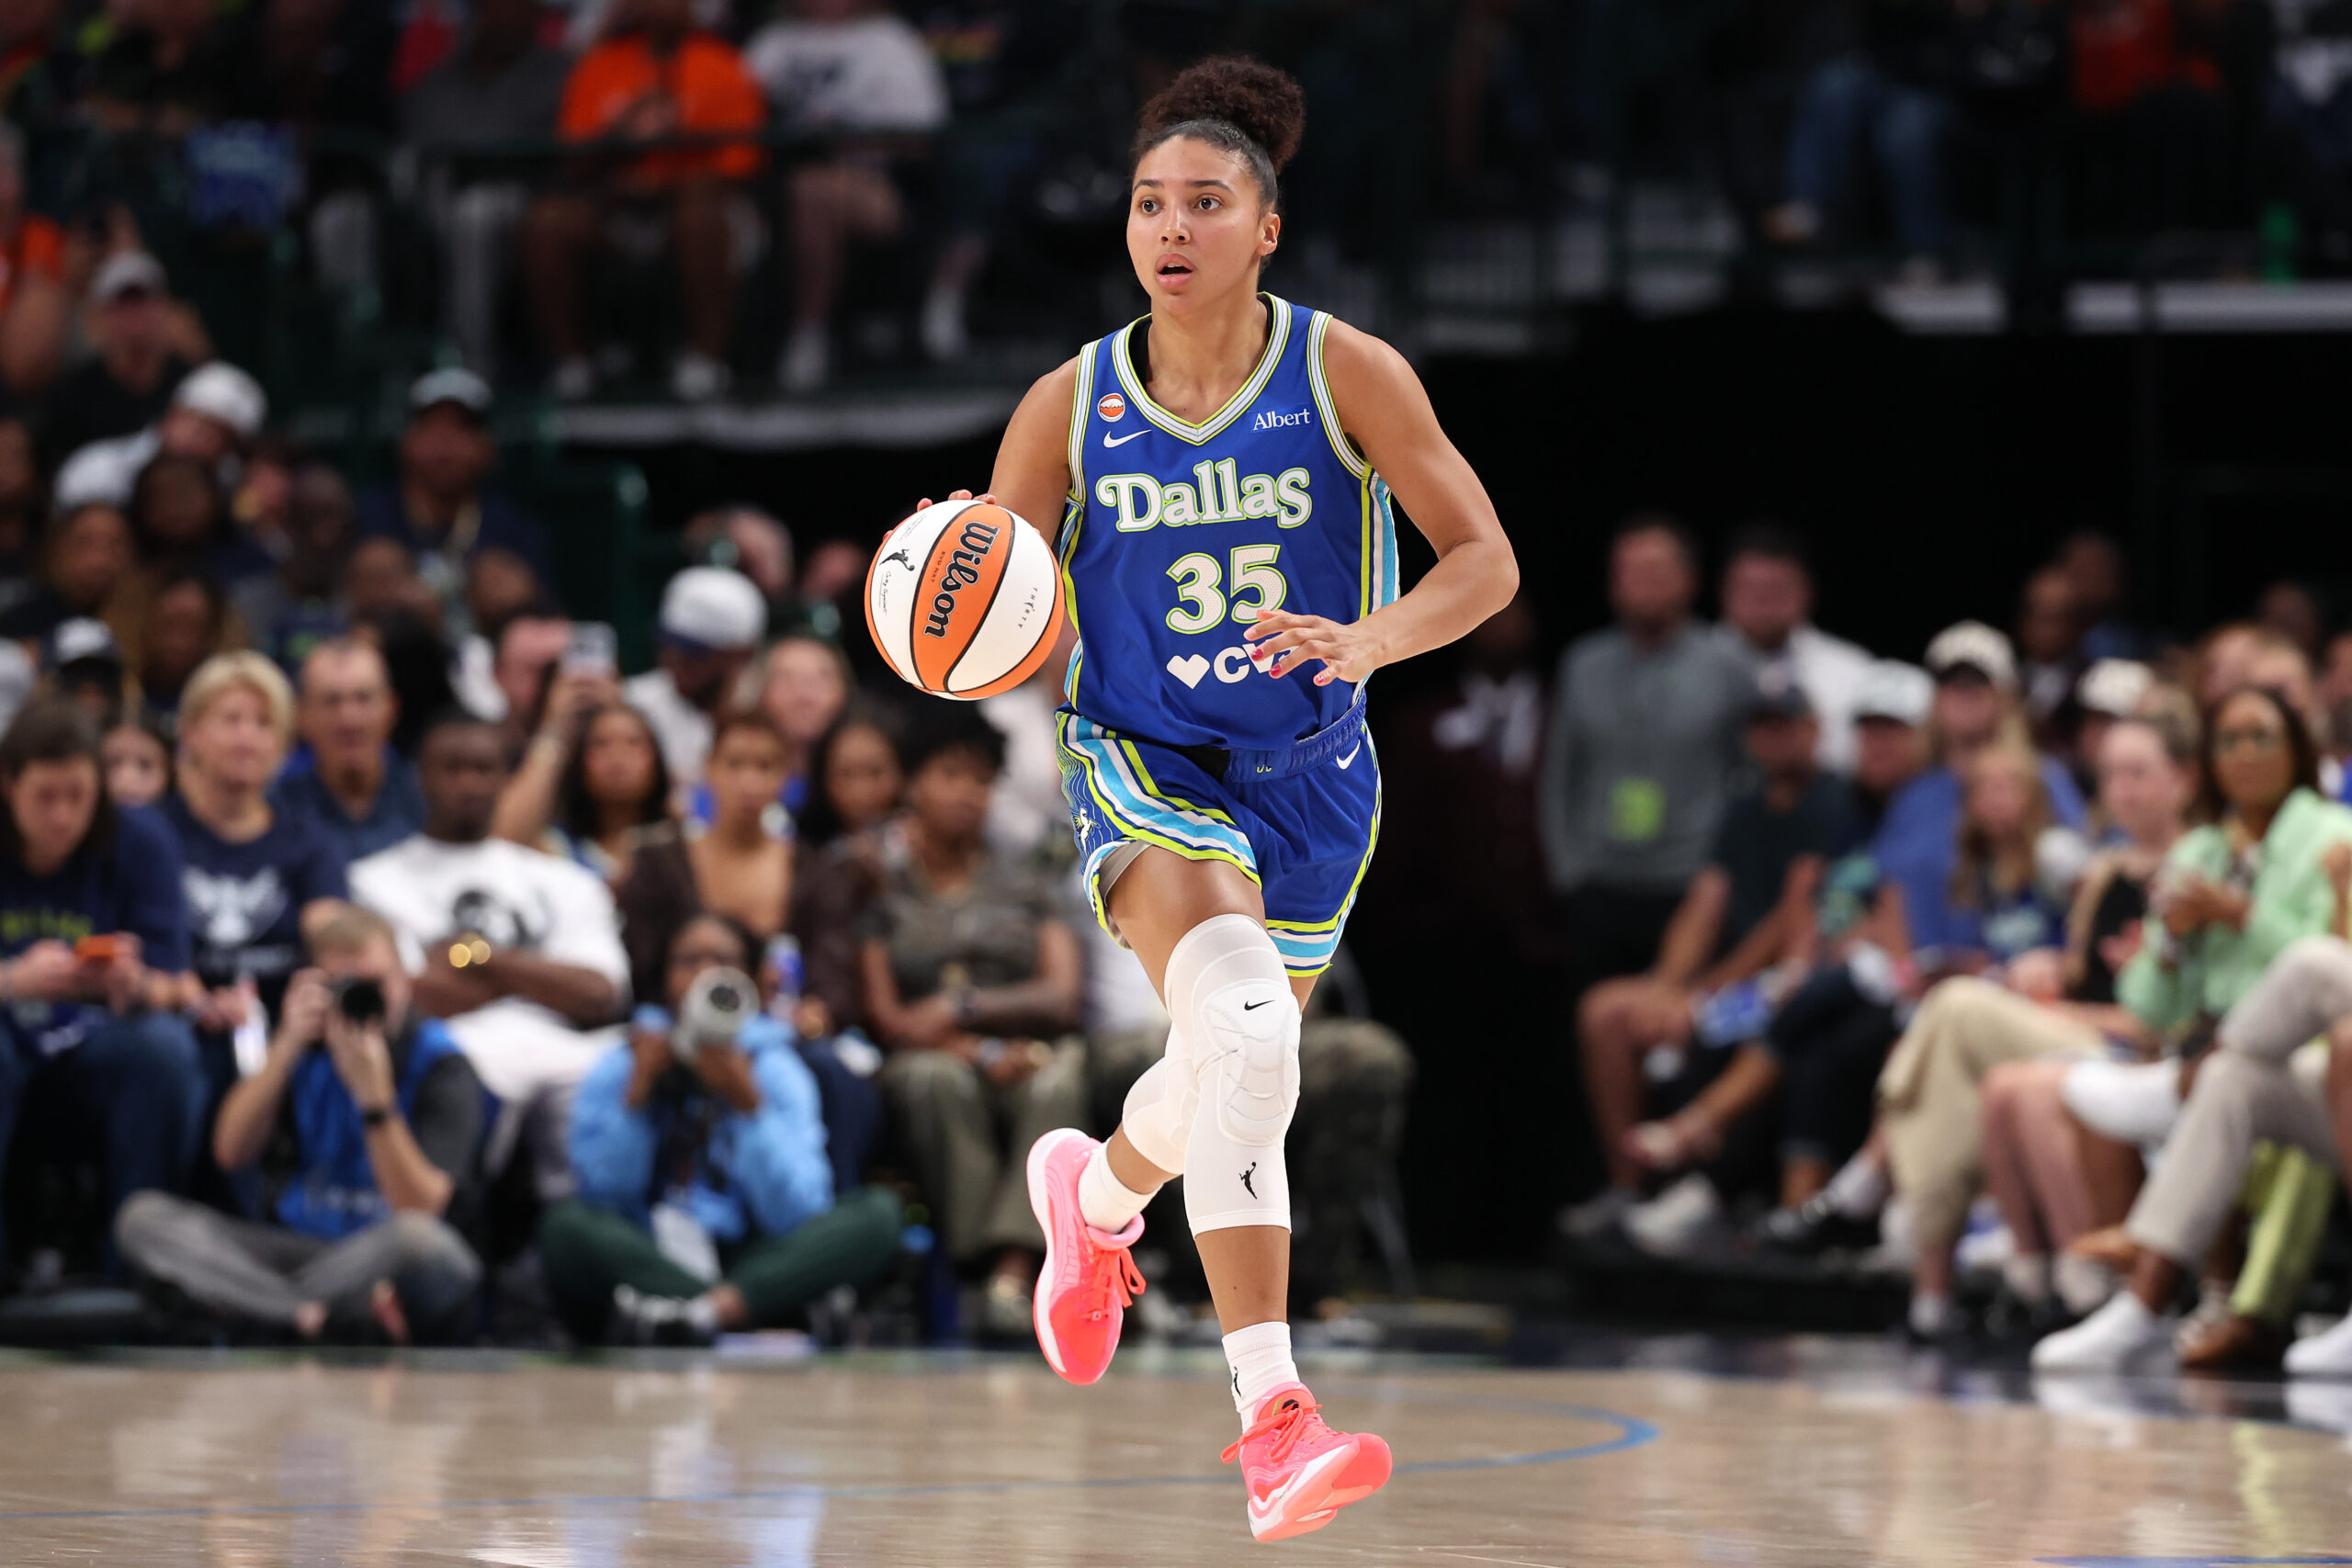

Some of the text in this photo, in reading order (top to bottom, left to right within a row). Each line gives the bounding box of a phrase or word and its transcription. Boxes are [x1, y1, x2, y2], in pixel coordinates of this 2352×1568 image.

[1252, 408, 1311, 431] Albert
[1095, 457, 1312, 532] Dallas
[923, 521, 1001, 638] Wilson
[1166, 544, 1287, 634] 35
[1213, 640, 1300, 683] CV
